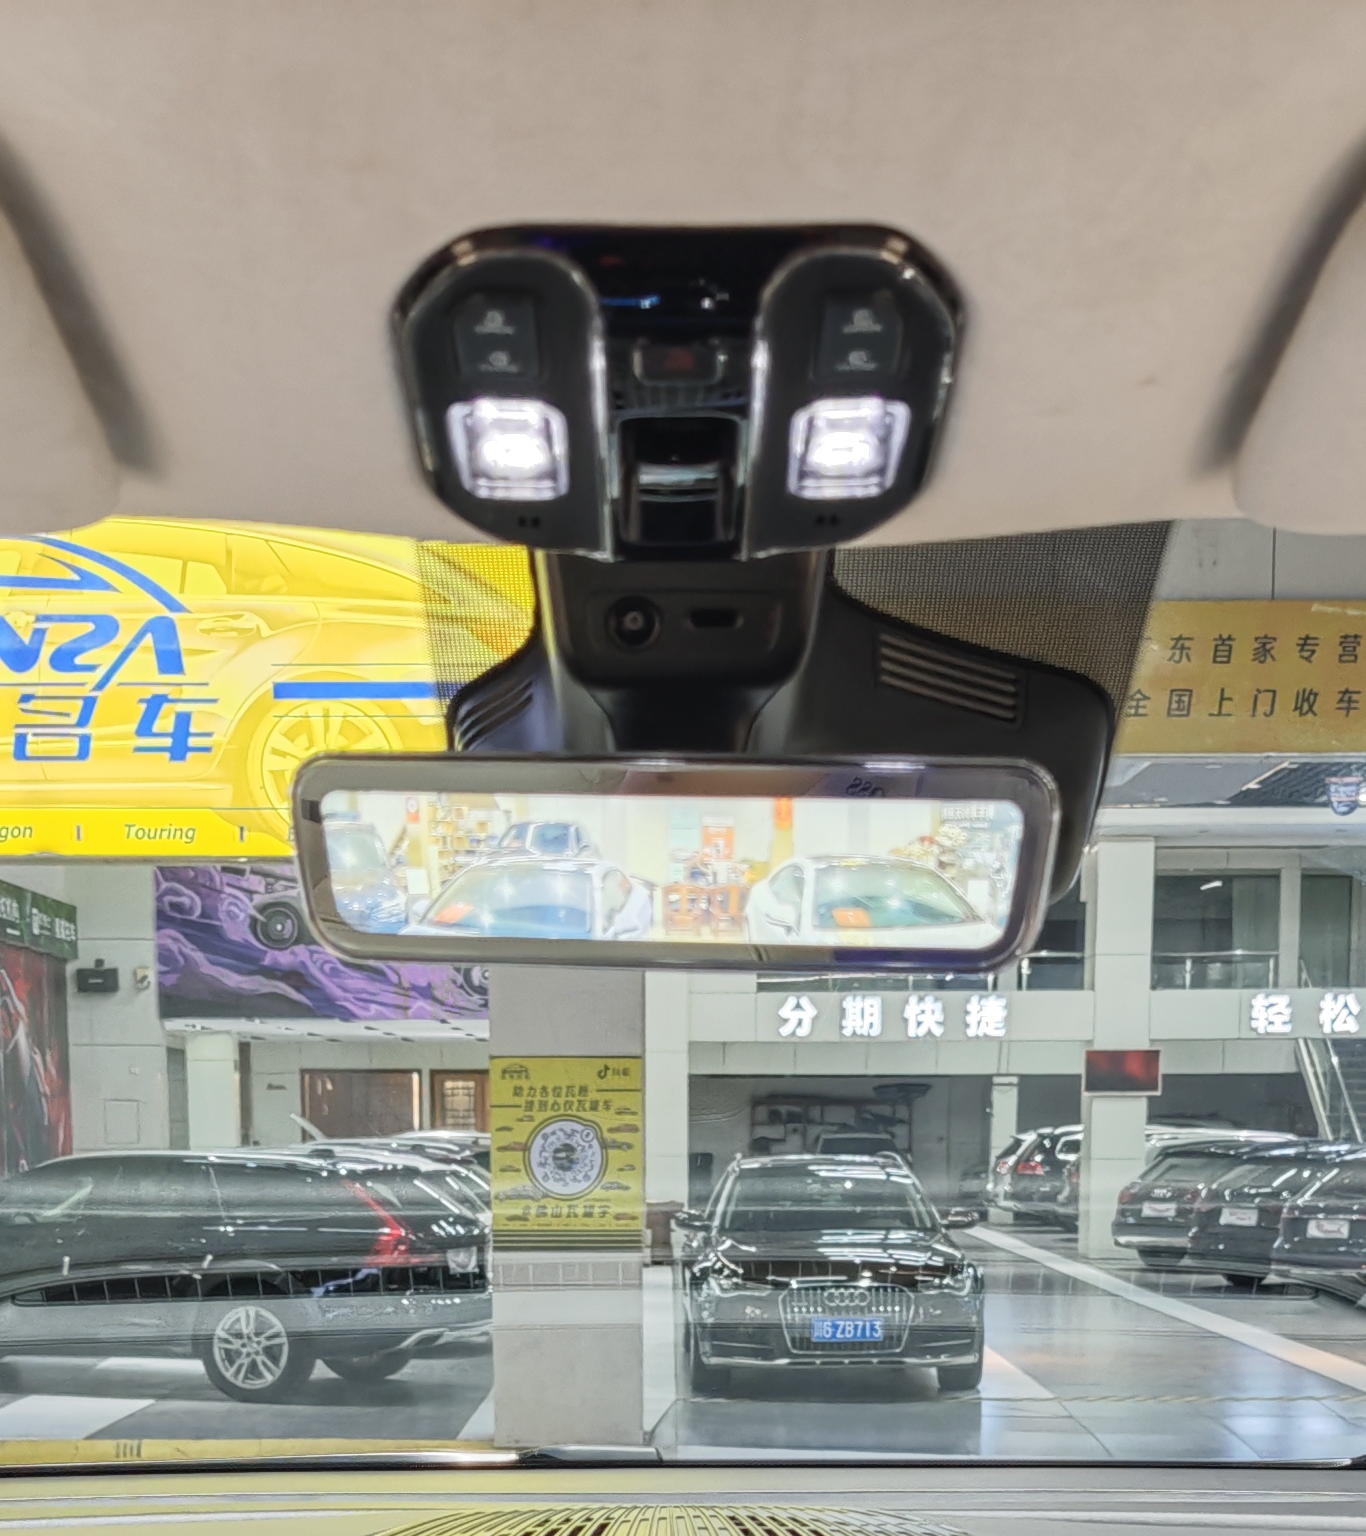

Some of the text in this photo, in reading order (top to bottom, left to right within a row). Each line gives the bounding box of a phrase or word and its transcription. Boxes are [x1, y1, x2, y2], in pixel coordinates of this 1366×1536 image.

[123, 822, 197, 846] Touring
[778, 995, 1008, 1038] 分期快捷
